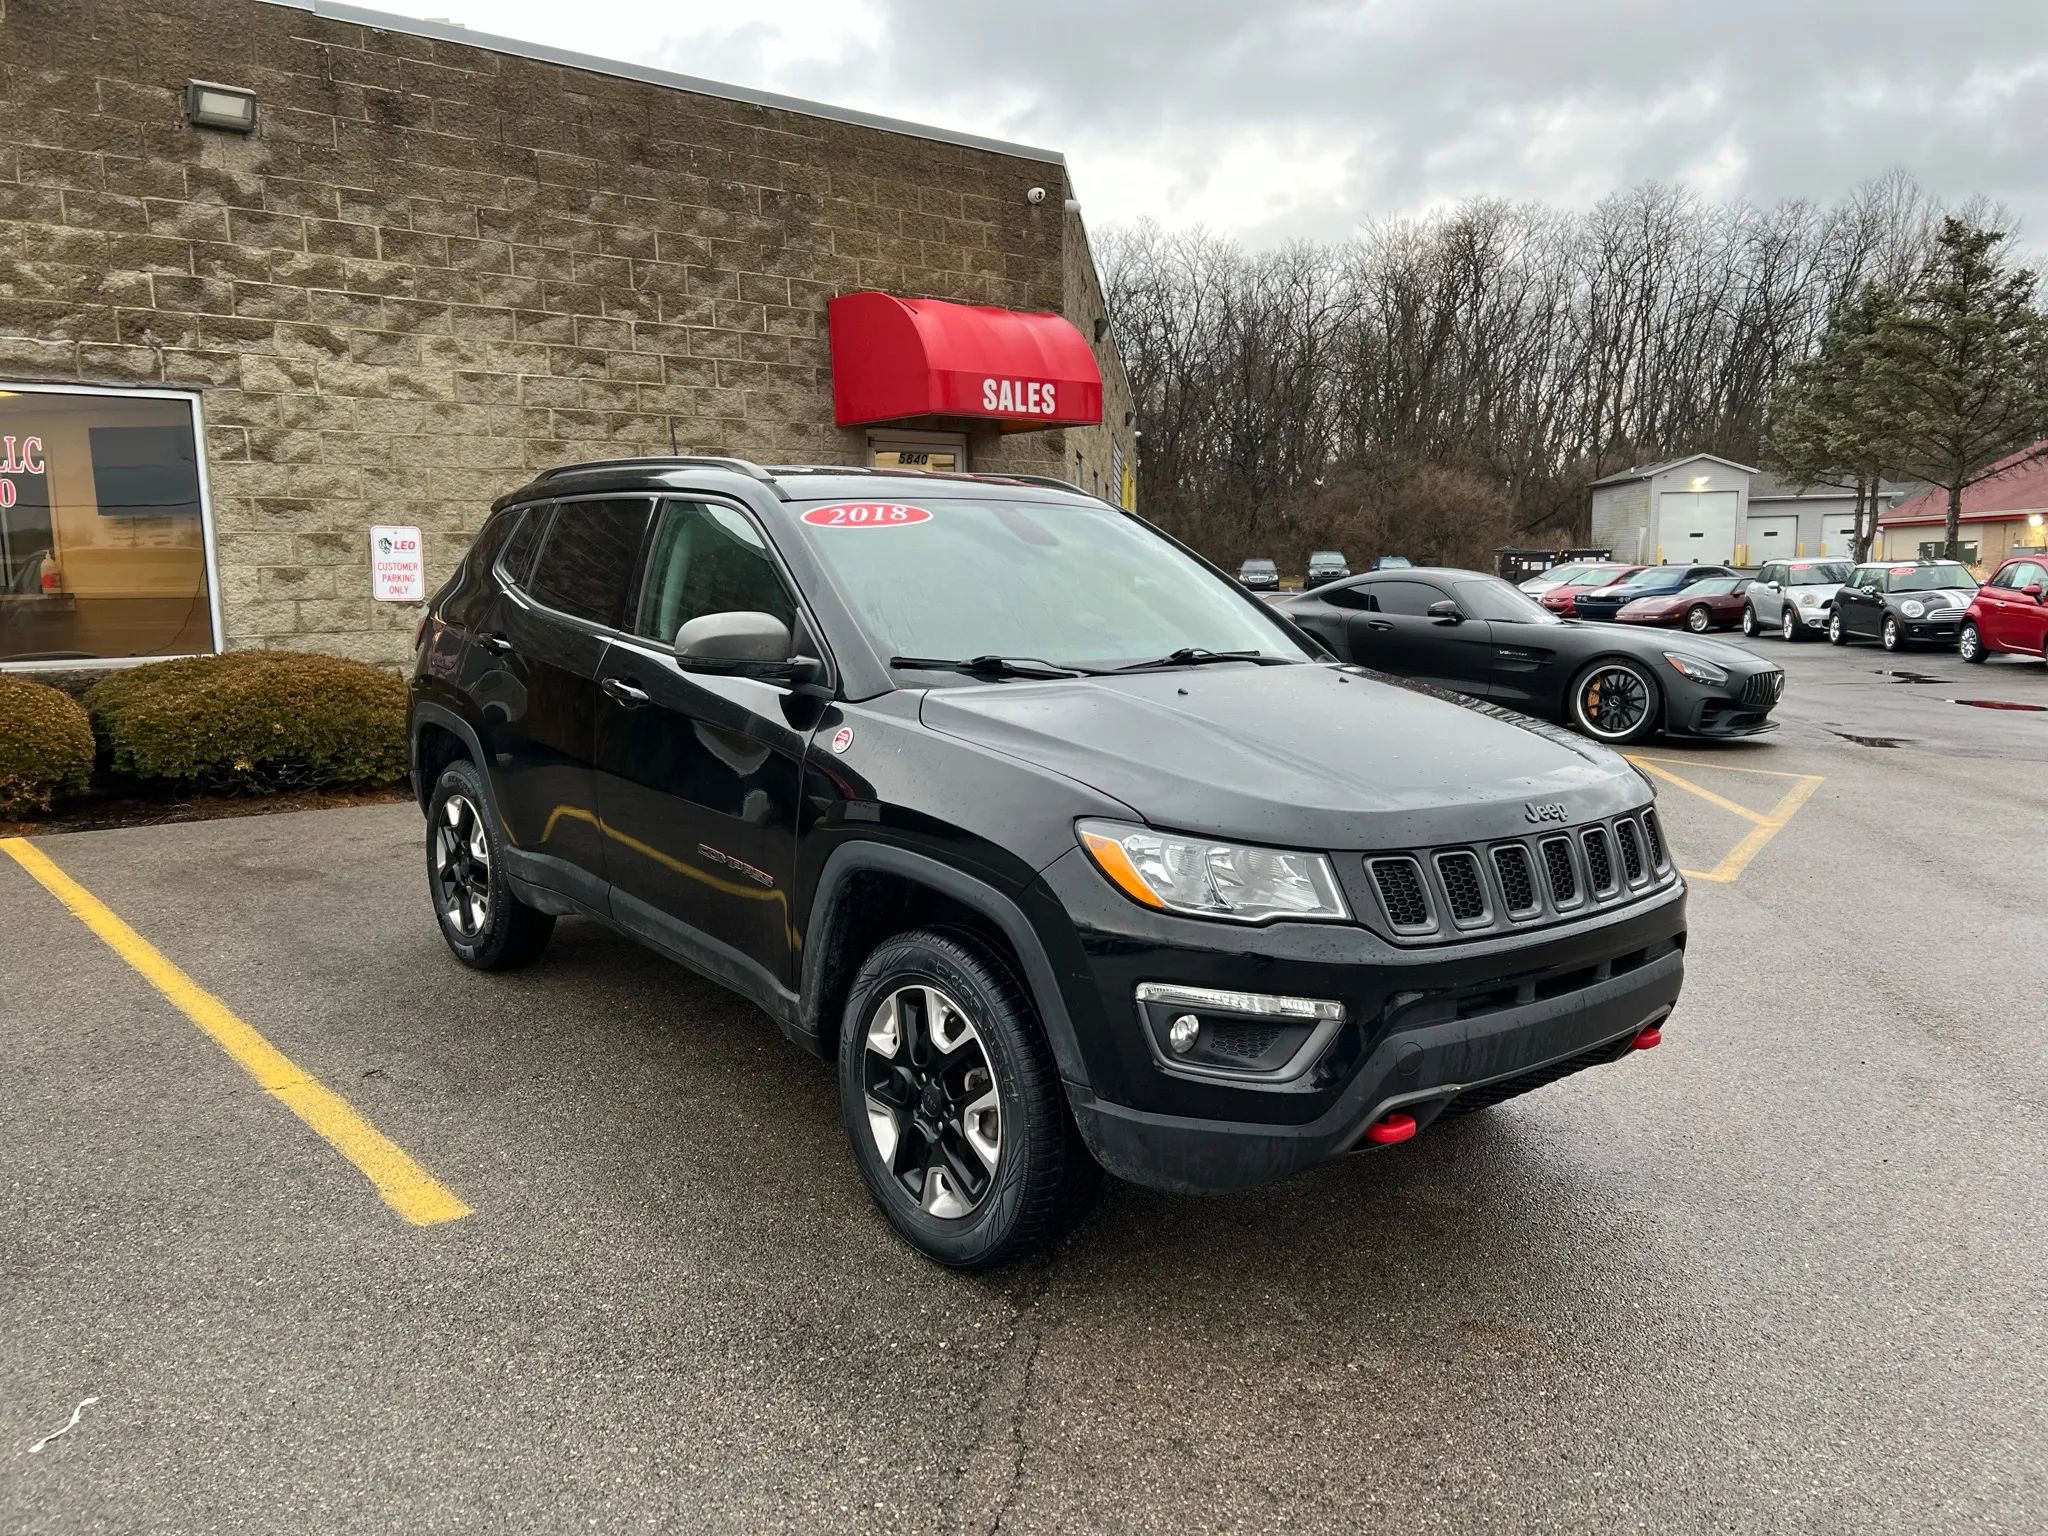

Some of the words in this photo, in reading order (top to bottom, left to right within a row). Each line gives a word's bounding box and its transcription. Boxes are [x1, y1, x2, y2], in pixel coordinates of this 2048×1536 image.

[982, 378, 1056, 414] SALES
[0, 435, 45, 475] LC
[899, 453, 928, 465] 5840
[828, 504, 909, 525] 2018
[393, 540, 416, 550] LEO
[377, 562, 418, 571] CUSTOMER
[382, 574, 416, 583] PARKING
[388, 586, 409, 594] ONLY
[1524, 802, 1569, 824] Jeep
